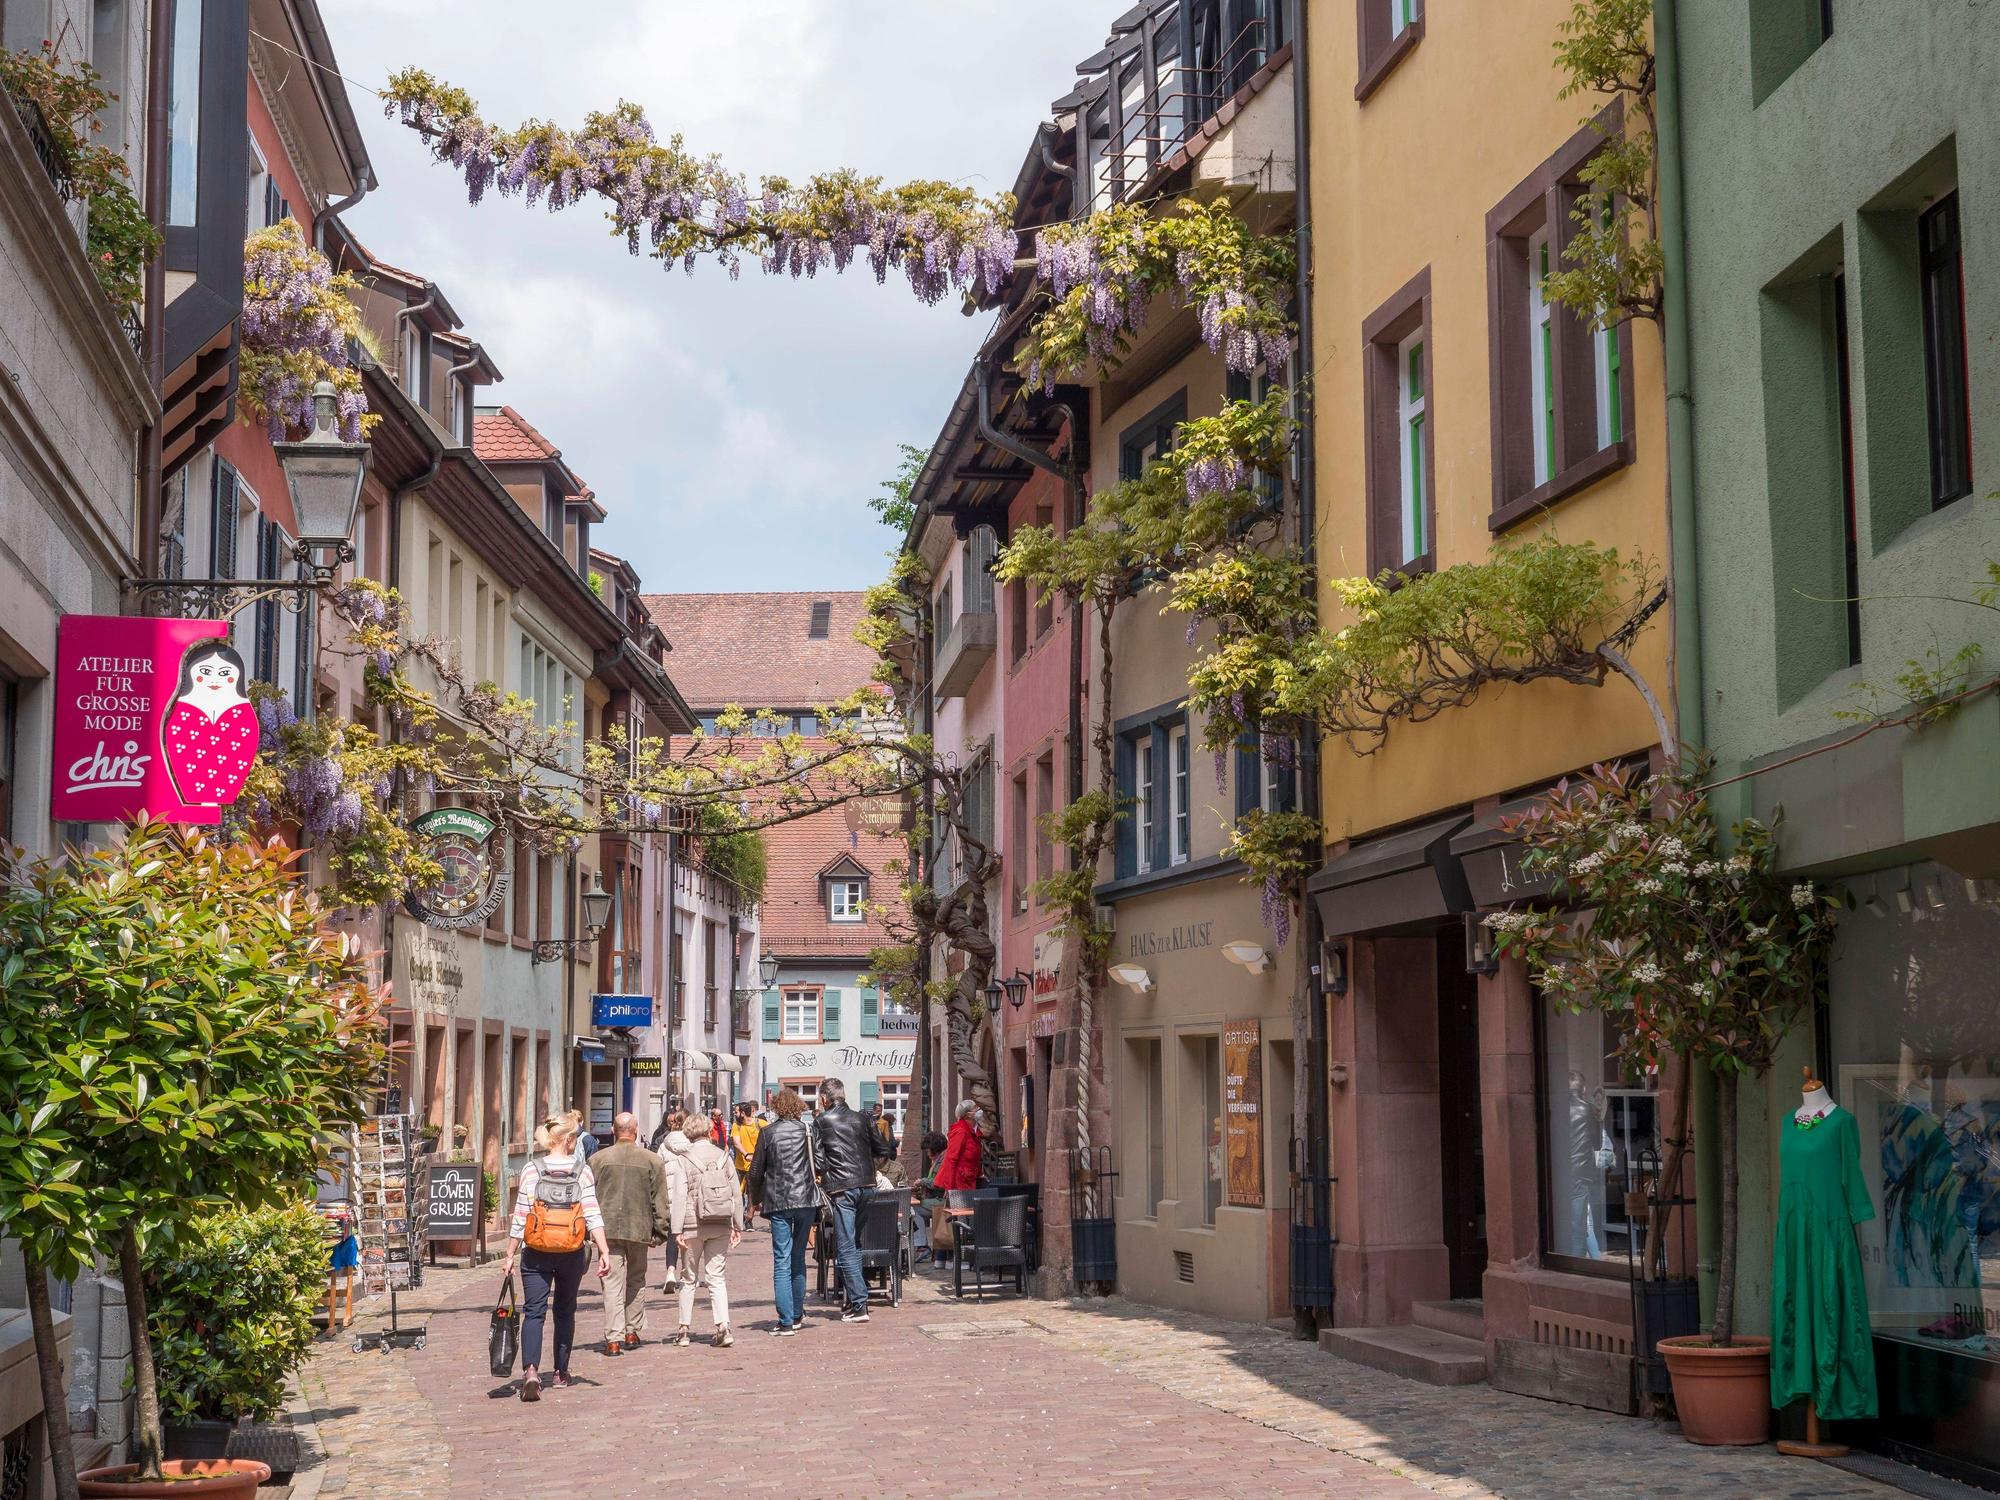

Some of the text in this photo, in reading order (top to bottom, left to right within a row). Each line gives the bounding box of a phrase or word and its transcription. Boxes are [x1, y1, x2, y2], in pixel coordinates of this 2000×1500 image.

[77, 656, 155, 674] ATELIER
[96, 674, 135, 692] FÜR
[76, 694, 151, 713] GROSSE
[84, 715, 142, 731] MODE
[68, 740, 152, 781] chris
[1130, 921, 1213, 958] HAUS ZUR KLAUSE
[610, 1004, 650, 1018] philoro
[1225, 1031, 1258, 1046] ORTIGIA
[631, 1061, 660, 1070] MIRJAM
[832, 1045, 916, 1071] Wirtschaf
[1227, 1089, 1236, 1099] DIE
[430, 1182, 474, 1199] LÖWEN
[429, 1201, 474, 1217] GRUBE
[1953, 1302, 2000, 1332] RUND
